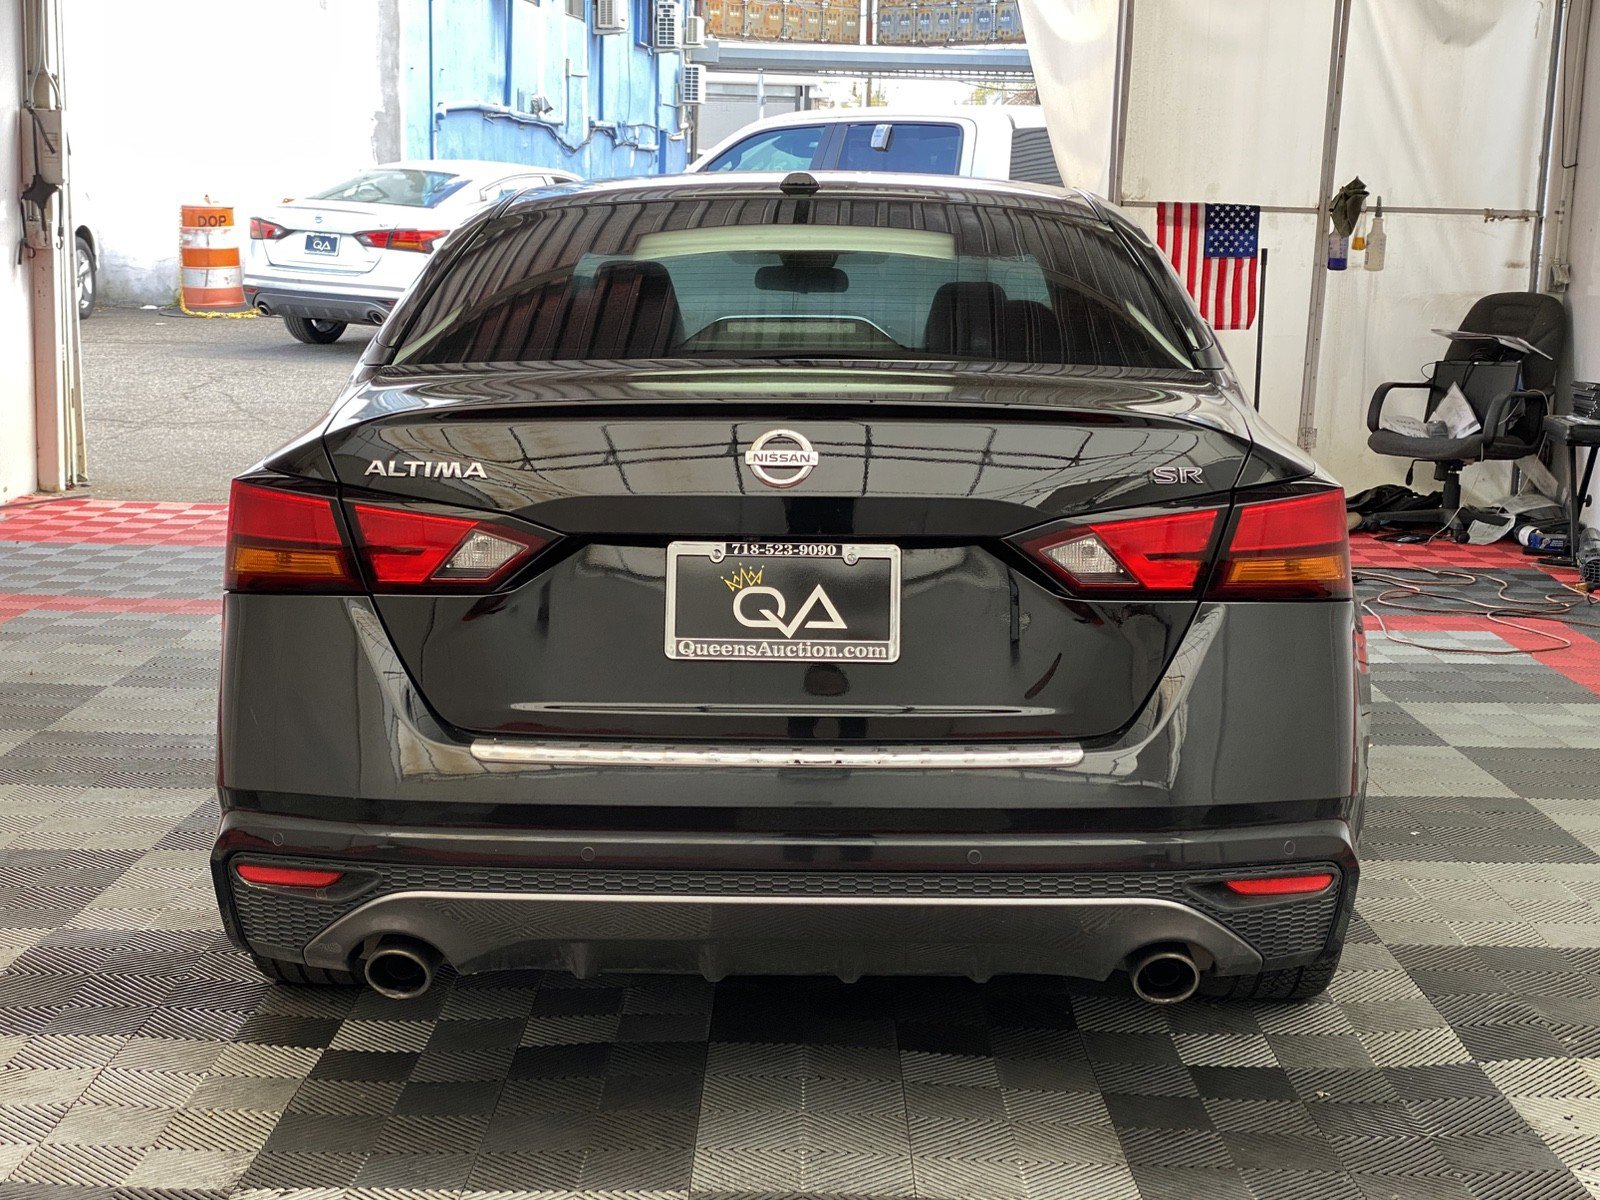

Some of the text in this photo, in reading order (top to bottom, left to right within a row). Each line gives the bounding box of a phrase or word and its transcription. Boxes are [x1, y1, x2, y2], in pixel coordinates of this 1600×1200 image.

[198, 215, 227, 227] DOP
[753, 453, 811, 463] NISSAN
[364, 460, 488, 479] ALTIMA
[1153, 466, 1204, 484] SR
[732, 544, 836, 556] 718-523-9090
[733, 584, 848, 639] QA
[678, 640, 887, 658] QueensAuction.com
